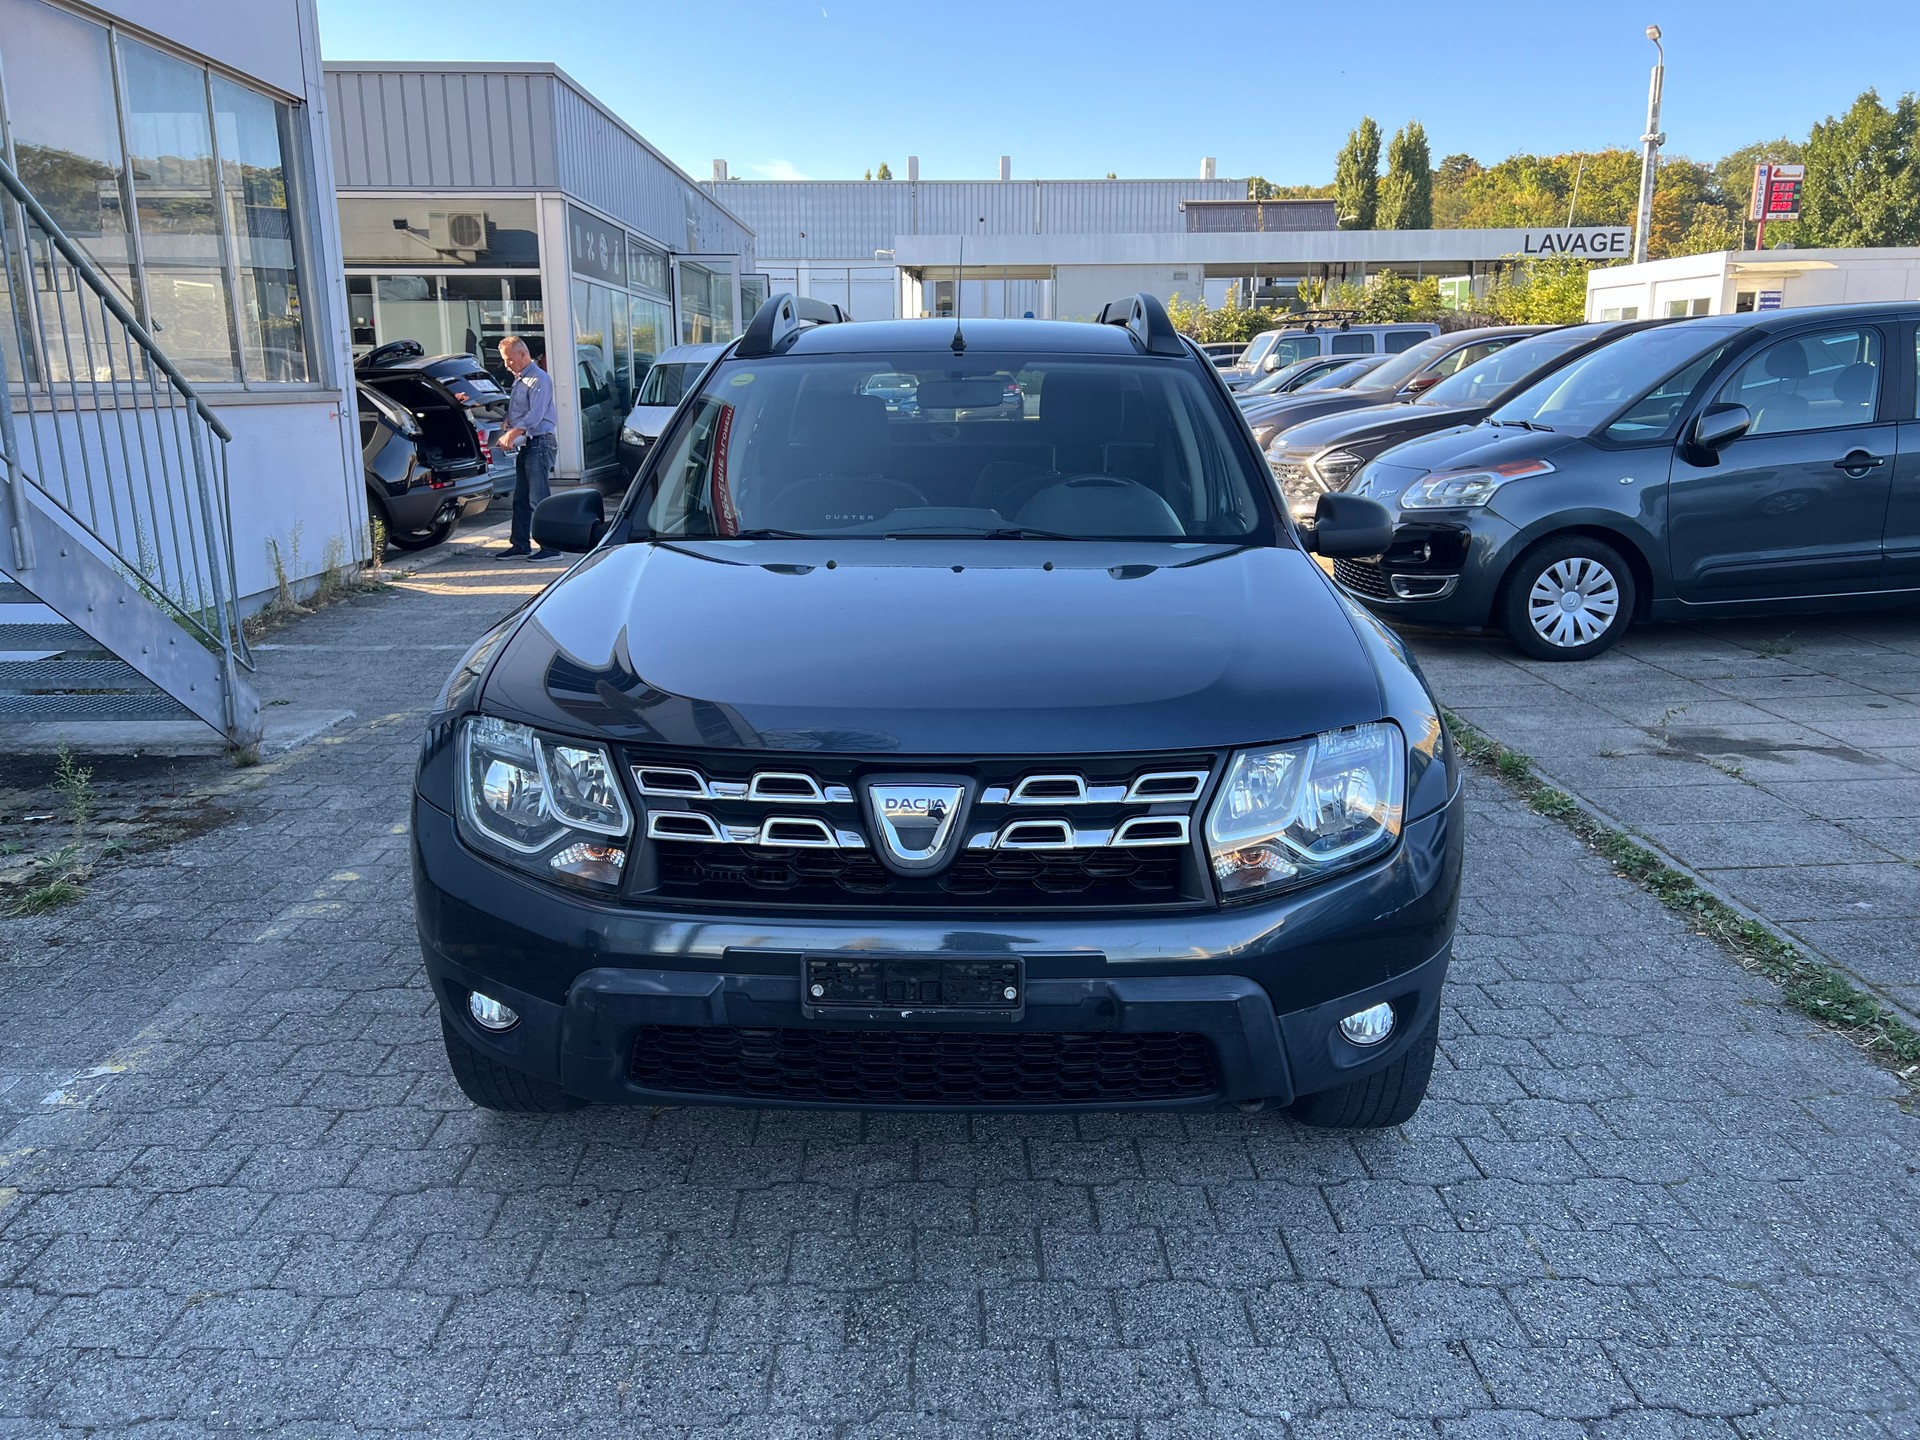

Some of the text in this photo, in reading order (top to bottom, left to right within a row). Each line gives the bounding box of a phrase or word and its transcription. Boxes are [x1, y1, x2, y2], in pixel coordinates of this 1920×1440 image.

[1756, 180, 1764, 216] LAVAGE
[1524, 232, 1625, 253] LAVAGE
[885, 798, 947, 810] DACIA
